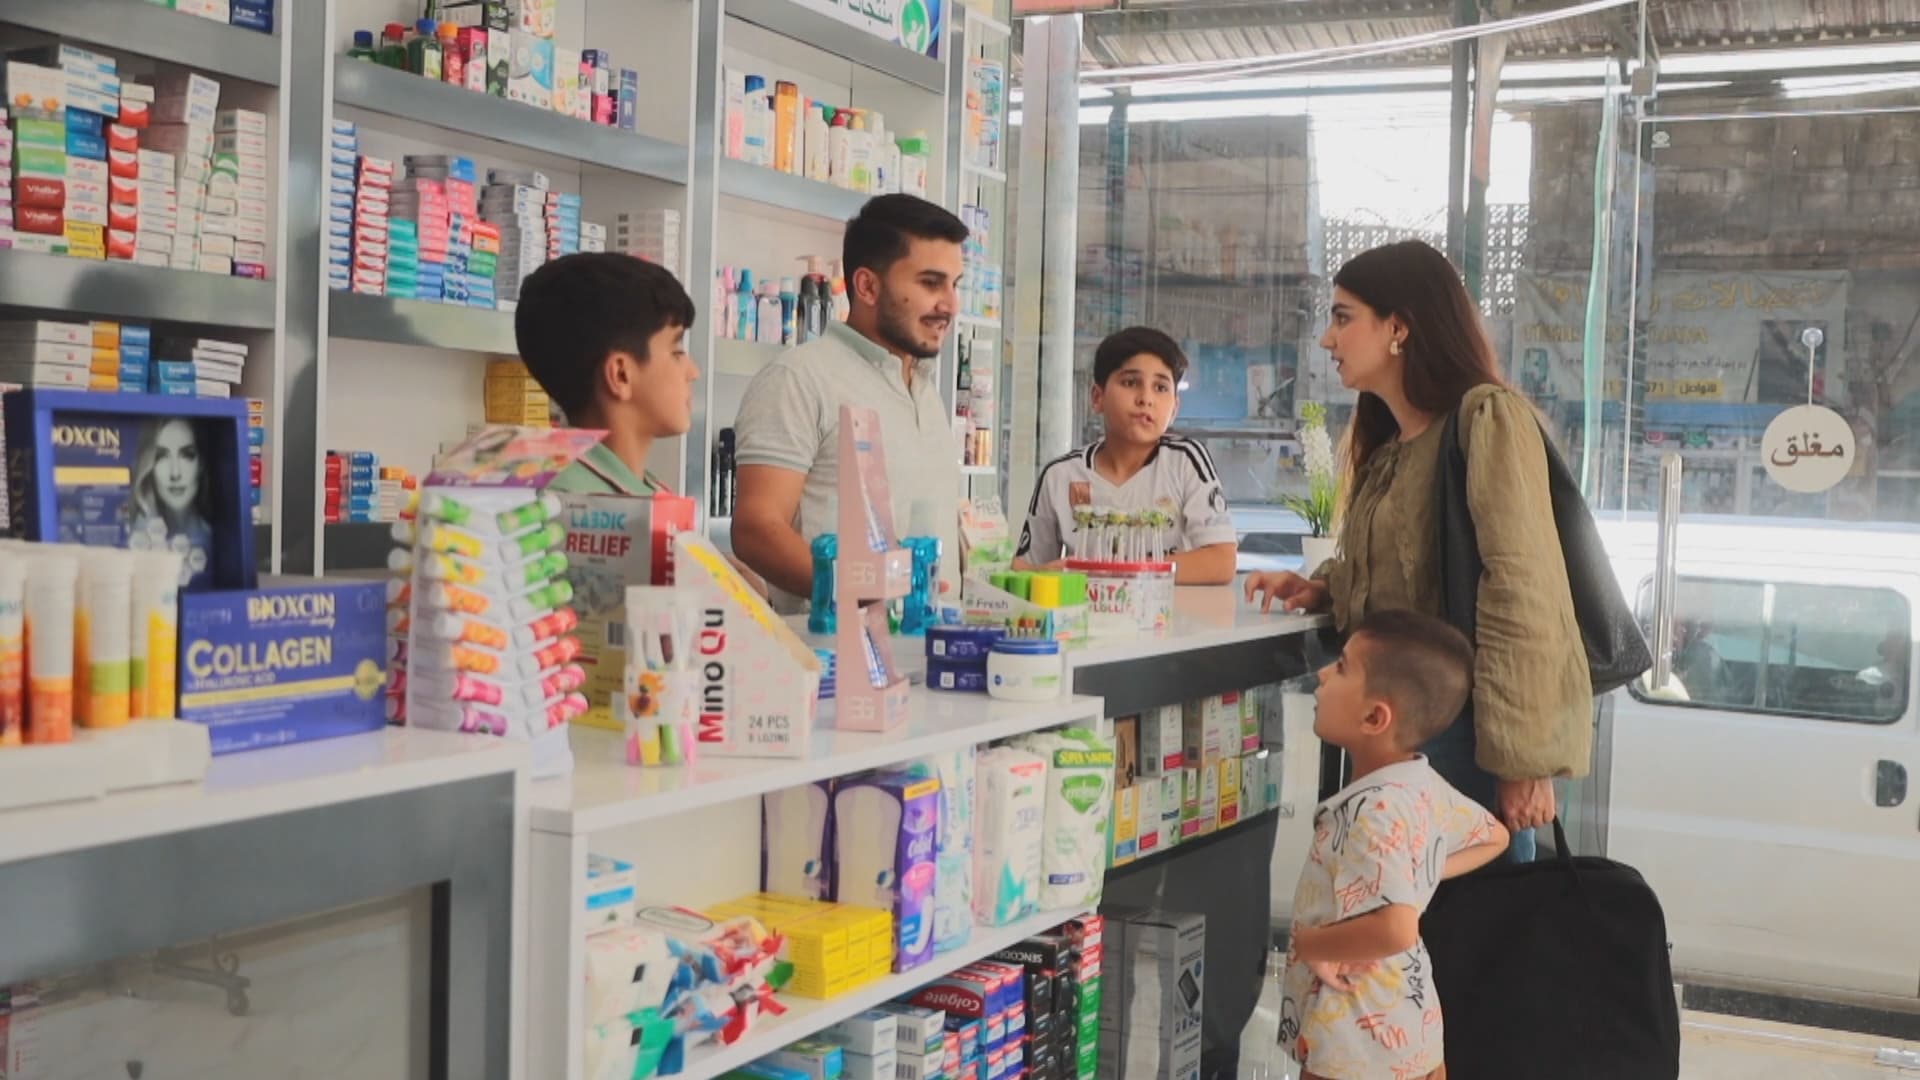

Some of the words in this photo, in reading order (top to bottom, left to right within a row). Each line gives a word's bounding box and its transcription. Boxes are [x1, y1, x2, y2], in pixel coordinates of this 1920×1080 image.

[1771, 432, 1844, 467] مغلق
[565, 532, 633, 557] RELIEF
[976, 599, 1008, 610] Fresh
[748, 715, 763, 728] 24
[767, 715, 791, 729] PCS
[924, 990, 981, 1012] Colgate
[1355, 1012, 1409, 1050] Fun
